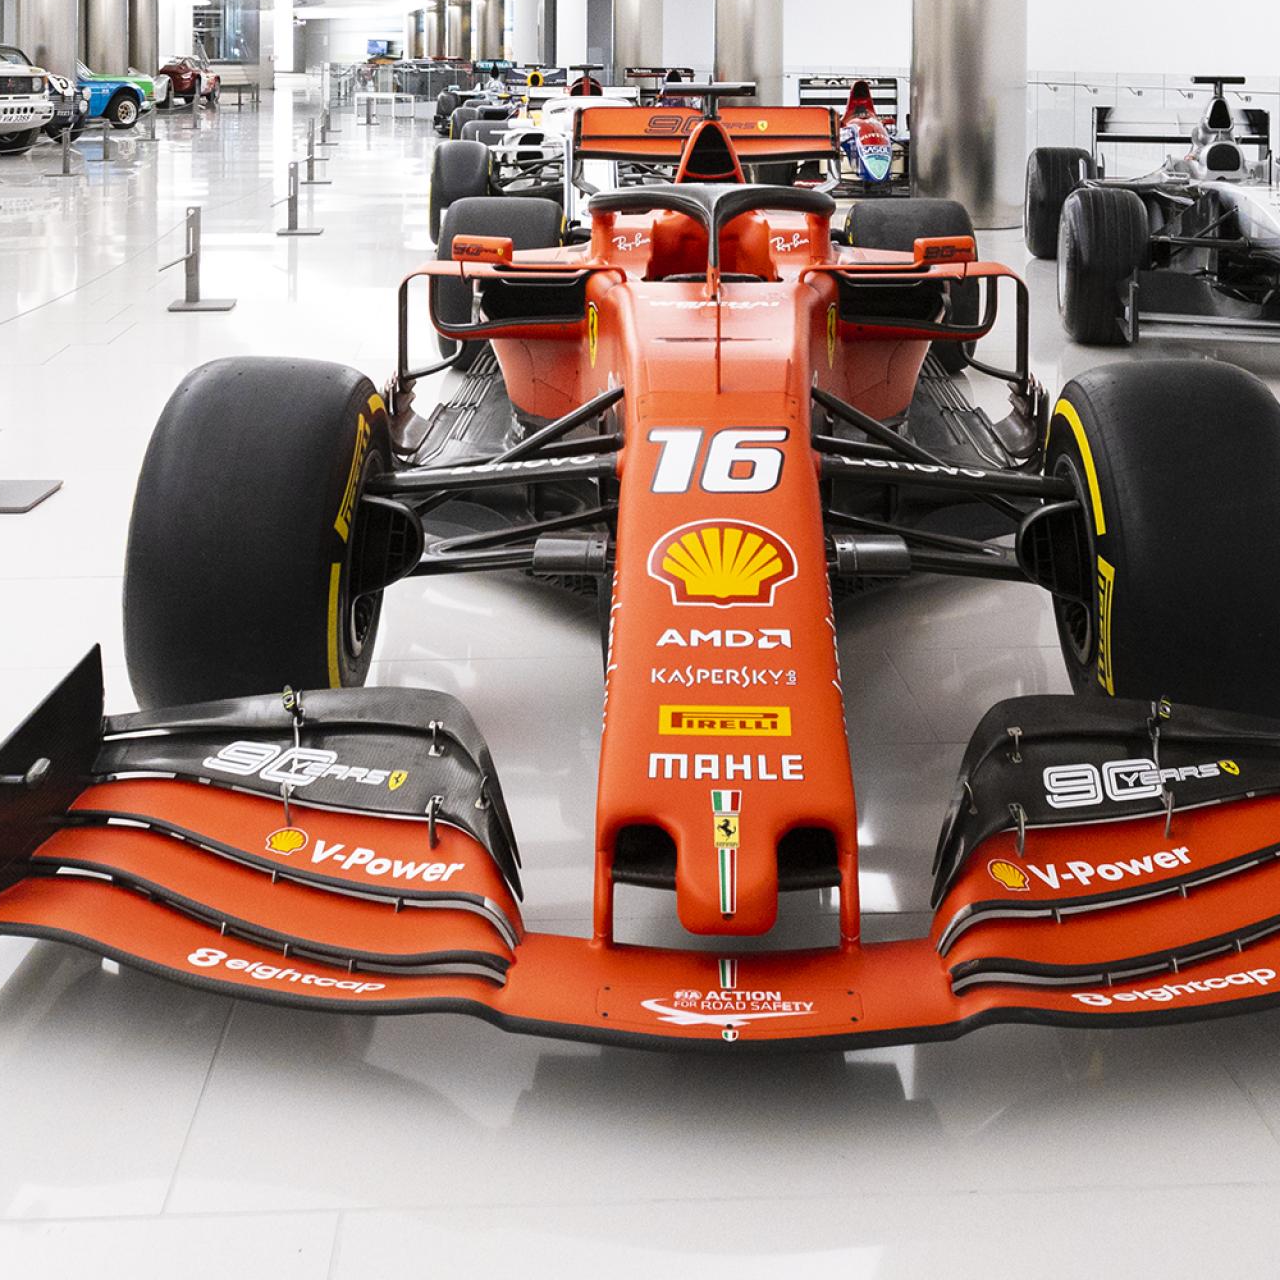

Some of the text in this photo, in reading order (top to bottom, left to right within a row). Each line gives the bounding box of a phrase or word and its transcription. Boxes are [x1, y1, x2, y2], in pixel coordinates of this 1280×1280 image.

[612, 232, 651, 251] Ray-Ban
[770, 232, 810, 252] Ray-Ban
[646, 426, 790, 494] 16
[655, 628, 754, 648] AMD
[650, 666, 785, 688] KASPERSKY
[671, 711, 780, 730] PIRELLI
[648, 753, 804, 781] MAHLE
[310, 839, 465, 882] V-Power
[1026, 845, 1193, 890] V-Power
[224, 955, 386, 994] eightcap
[1111, 968, 1277, 1003] eightcap
[674, 1000, 814, 1012] FOR ROAD SAFETY
[705, 990, 782, 1001] ACTION
